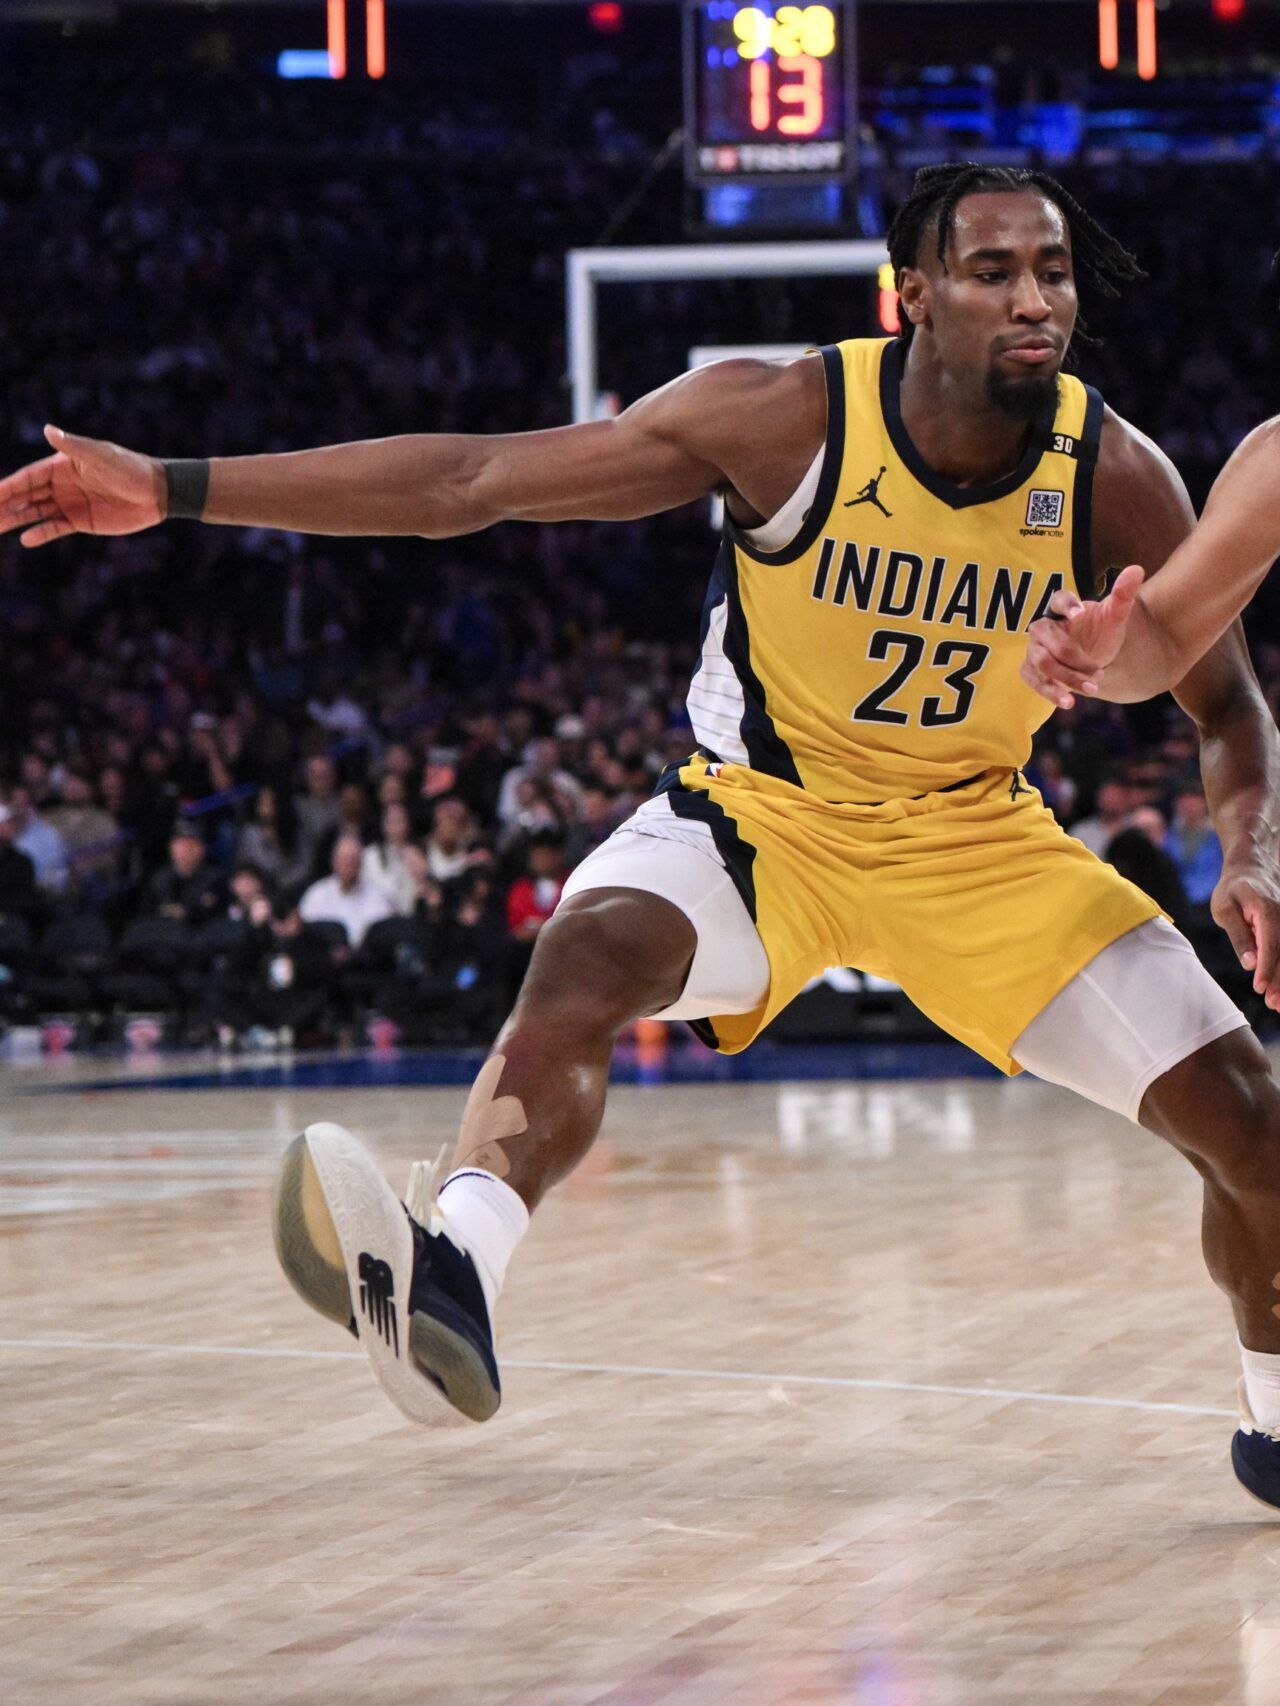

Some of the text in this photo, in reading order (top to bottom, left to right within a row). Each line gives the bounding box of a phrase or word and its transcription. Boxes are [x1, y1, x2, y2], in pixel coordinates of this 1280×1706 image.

[750, 54, 823, 135] 13
[1053, 435, 1073, 454] 30
[1019, 527, 1064, 538] spokenote
[850, 628, 991, 729] 23
